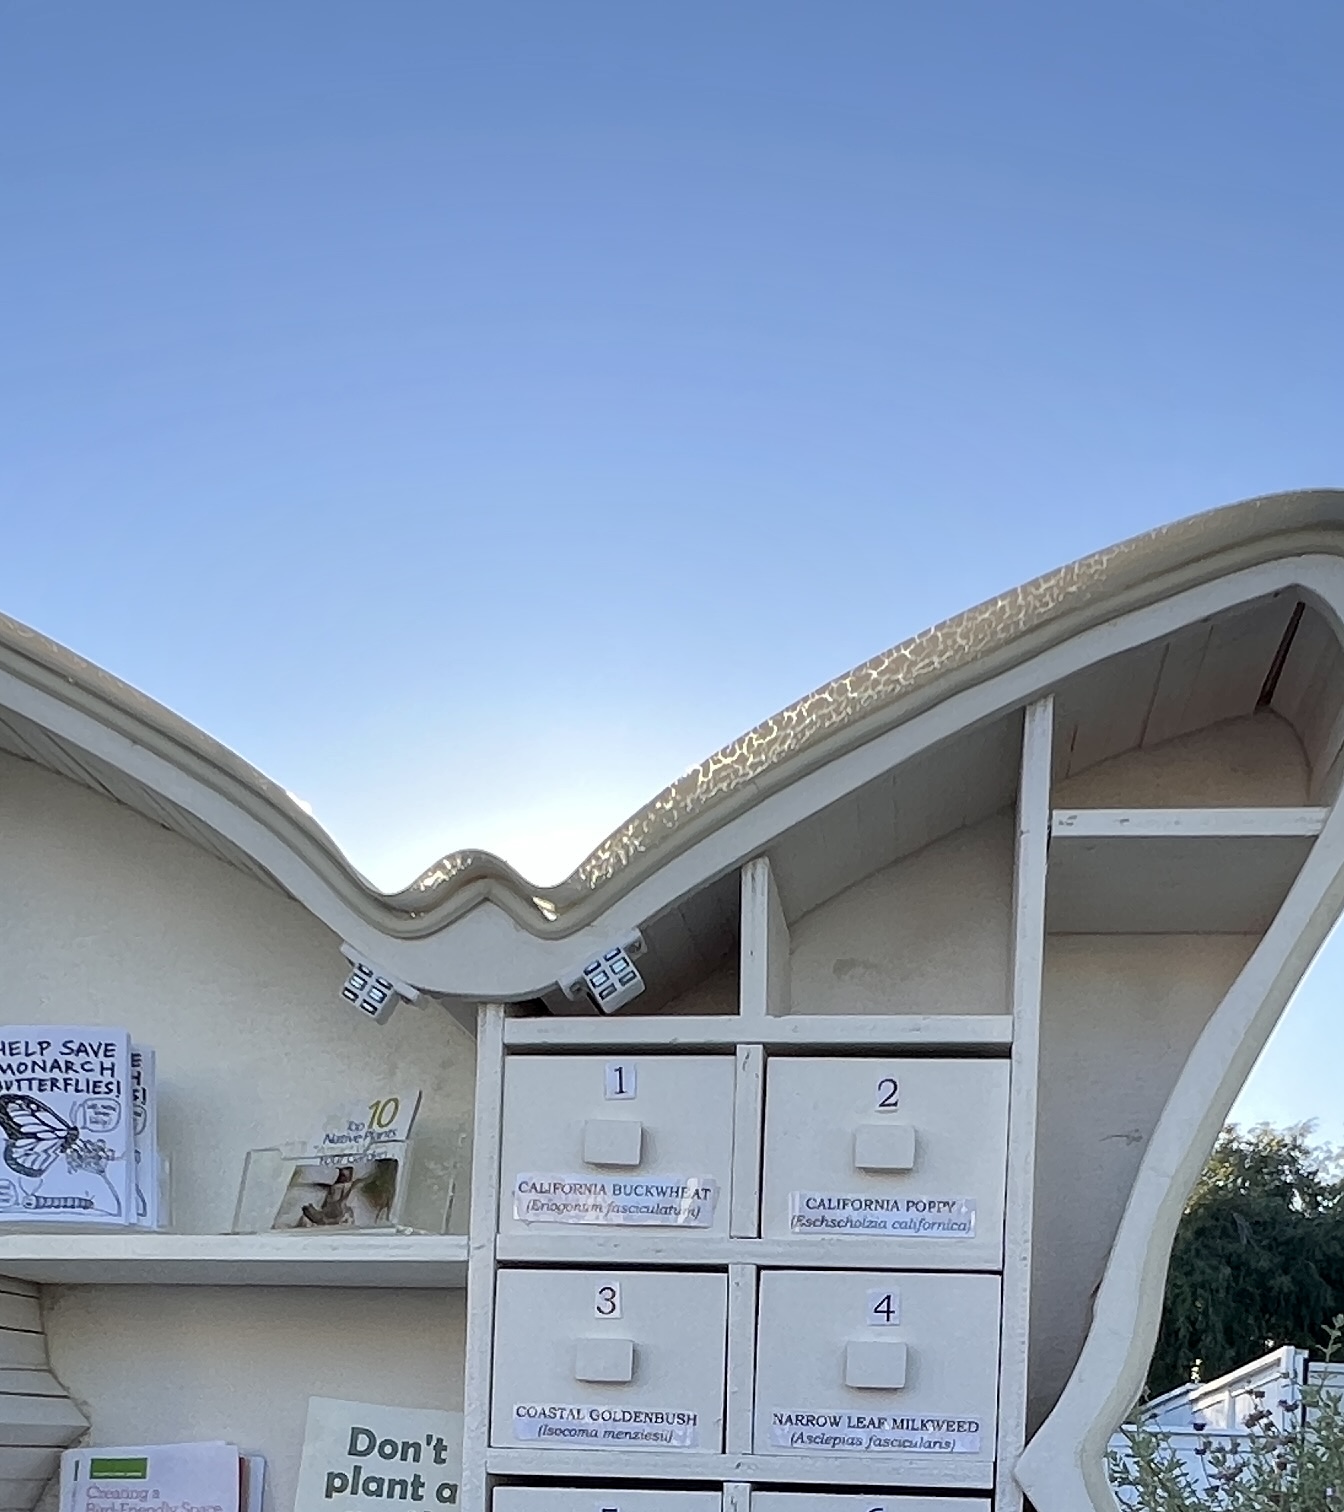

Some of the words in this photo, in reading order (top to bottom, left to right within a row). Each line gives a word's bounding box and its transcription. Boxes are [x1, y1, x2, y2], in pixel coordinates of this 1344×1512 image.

[59, 1040, 117, 1059] SAVE
[613, 1067, 626, 1094] 1
[877, 1079, 900, 1108] 2
[368, 1097, 399, 1129] 10
[518, 1181, 607, 1194] CALIFORNIA
[806, 1198, 900, 1212] CALIFORNIA
[906, 1200, 956, 1213] POPPY
[791, 1215, 887, 1229] (Eschscholzia
[891, 1218, 972, 1233] californica)
[596, 1287, 616, 1315] 3
[873, 1295, 895, 1323] 4
[516, 1406, 585, 1419] COASTAL
[589, 1409, 697, 1426] GOLDENBUSH
[773, 1413, 842, 1427] NARROW
[847, 1416, 887, 1429] LEAF
[892, 1418, 979, 1433] MILKWEED
[537, 1424, 598, 1438] (Isocoma
[791, 1432, 863, 1448] (Asclepias
[347, 1426, 448, 1464] Don't
[86, 1485, 150, 1501] Creating
[152, 1489, 160, 1499] a
[325, 1465, 425, 1501] plant
[435, 1482, 458, 1504] a
